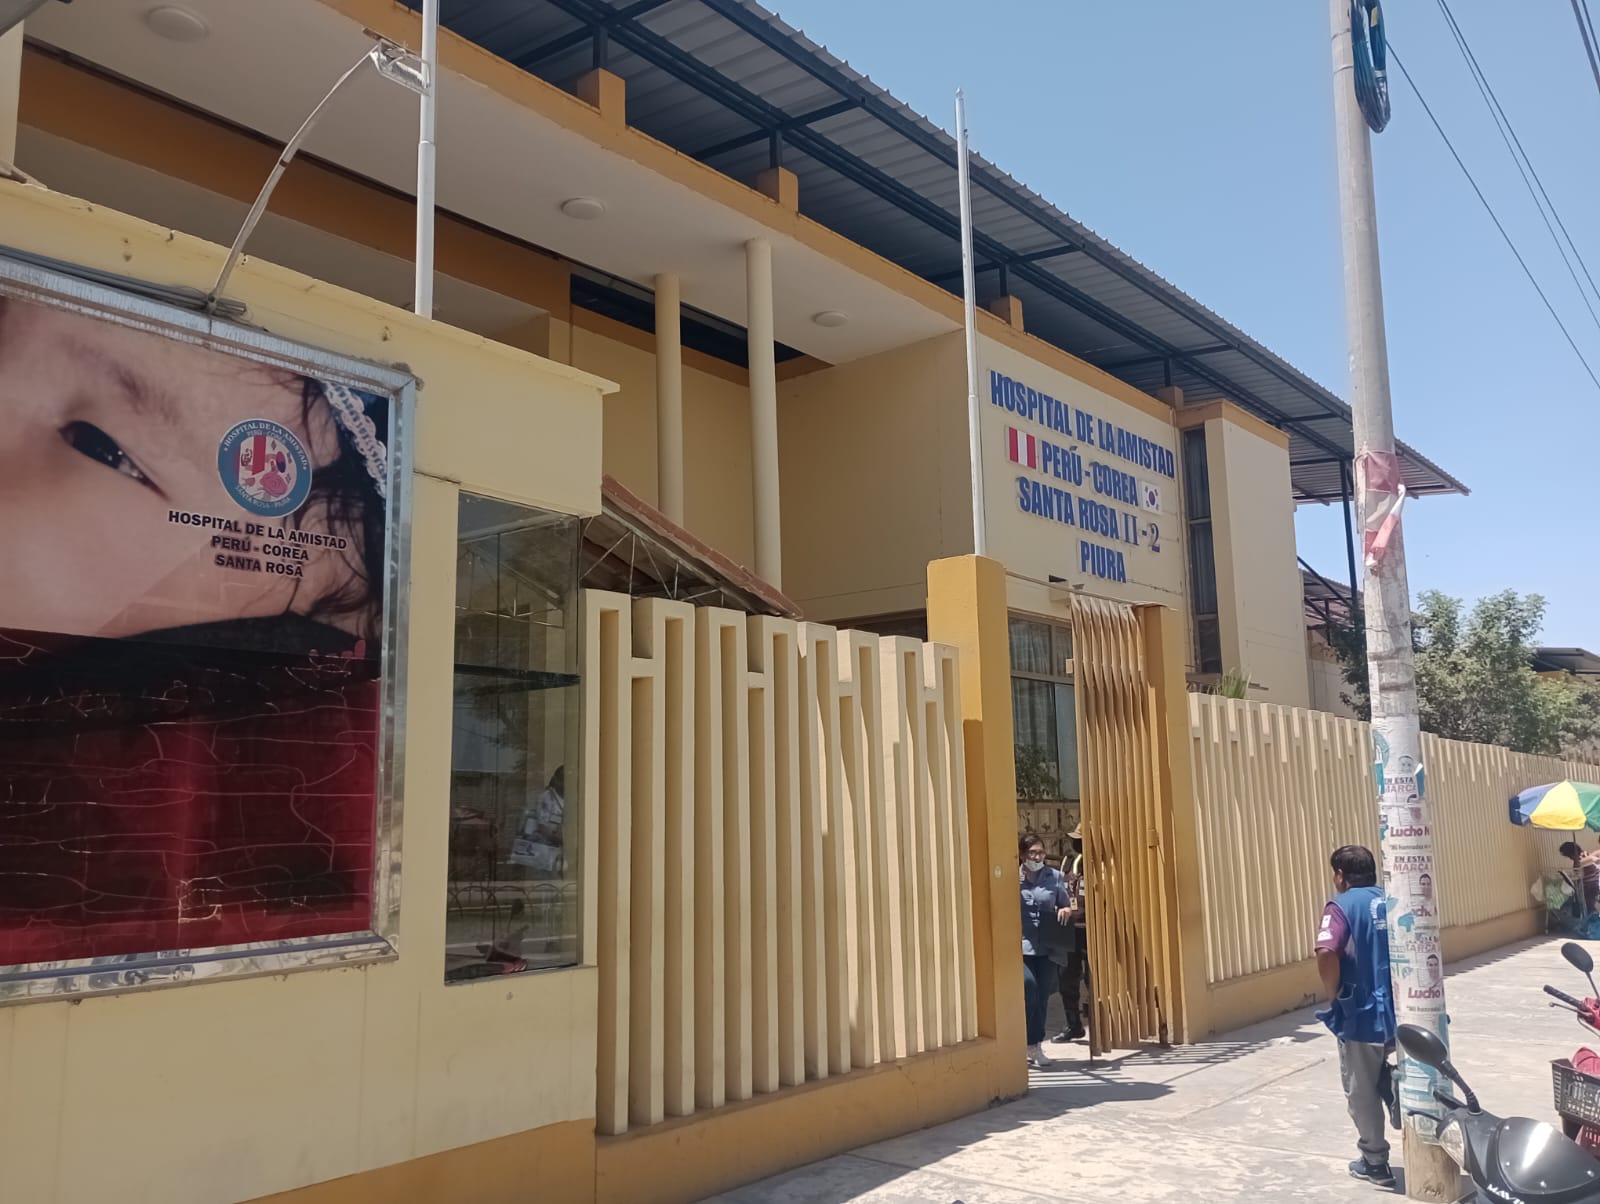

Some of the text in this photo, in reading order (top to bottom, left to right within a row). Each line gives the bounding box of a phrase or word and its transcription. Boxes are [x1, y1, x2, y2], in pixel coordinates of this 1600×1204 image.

[224, 423, 258, 447] HOSPITAL
[259, 422, 272, 430] DE
[990, 370, 1175, 479] HOSPITAL DE LA AMISTAD
[1019, 477, 1075, 525] SANTA
[1078, 496, 1119, 541] ROSA
[168, 510, 347, 550] HOSPITAL DE LA AMISTAD
[262, 544, 309, 561] COREA
[1080, 540, 1127, 584] PIURA
[215, 554, 304, 577] SANTA ROSA
[1395, 777, 1414, 785] ESTA
[1390, 825, 1423, 837] Lucho
[1395, 855, 1405, 863] EN
[1407, 855, 1425, 863] ESTA
[1408, 987, 1441, 999] Lucho
